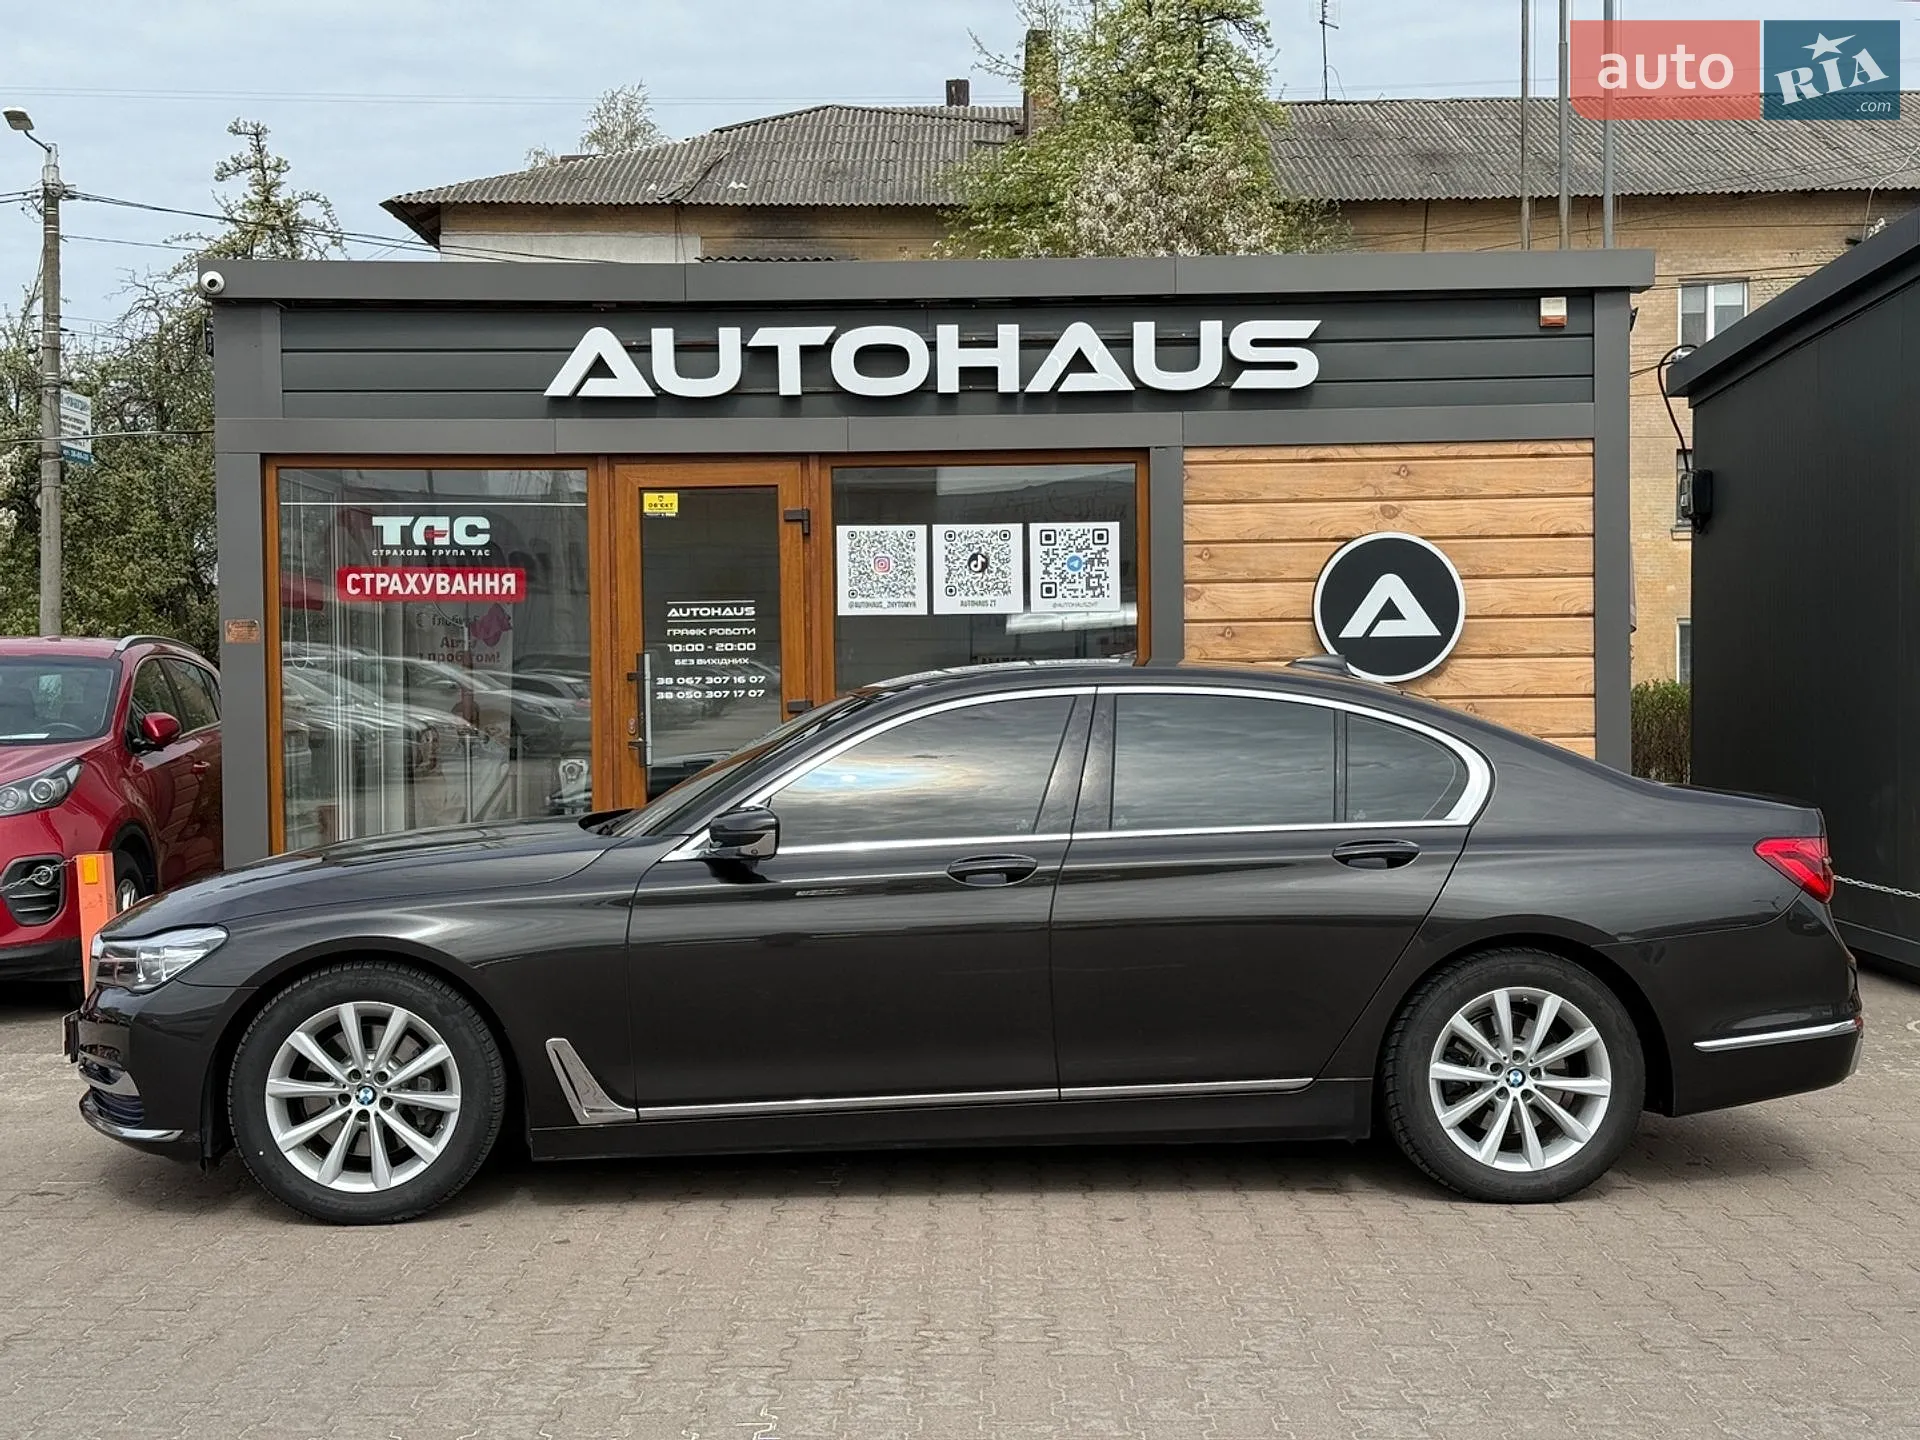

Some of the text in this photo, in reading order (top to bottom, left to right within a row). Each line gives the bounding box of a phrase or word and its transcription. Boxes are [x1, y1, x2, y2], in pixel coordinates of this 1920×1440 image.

[543, 320, 1323, 398] AUTOHAUS
[371, 549, 491, 557] СТРАХОВА ГРУПА ТАС
[346, 573, 517, 595] СТРАХУВАННЯ
[667, 606, 756, 617] AUTOHAUS
[666, 627, 756, 636] ГРАФІК РОБОТИ
[667, 643, 704, 652] 10:00
[715, 642, 756, 652] 20:00
[674, 657, 750, 666] БЕЗ ВИХІДНИХ
[655, 675, 765, 685] 38 067 307 16 07
[655, 689, 765, 700] 38 050 307 17 07
